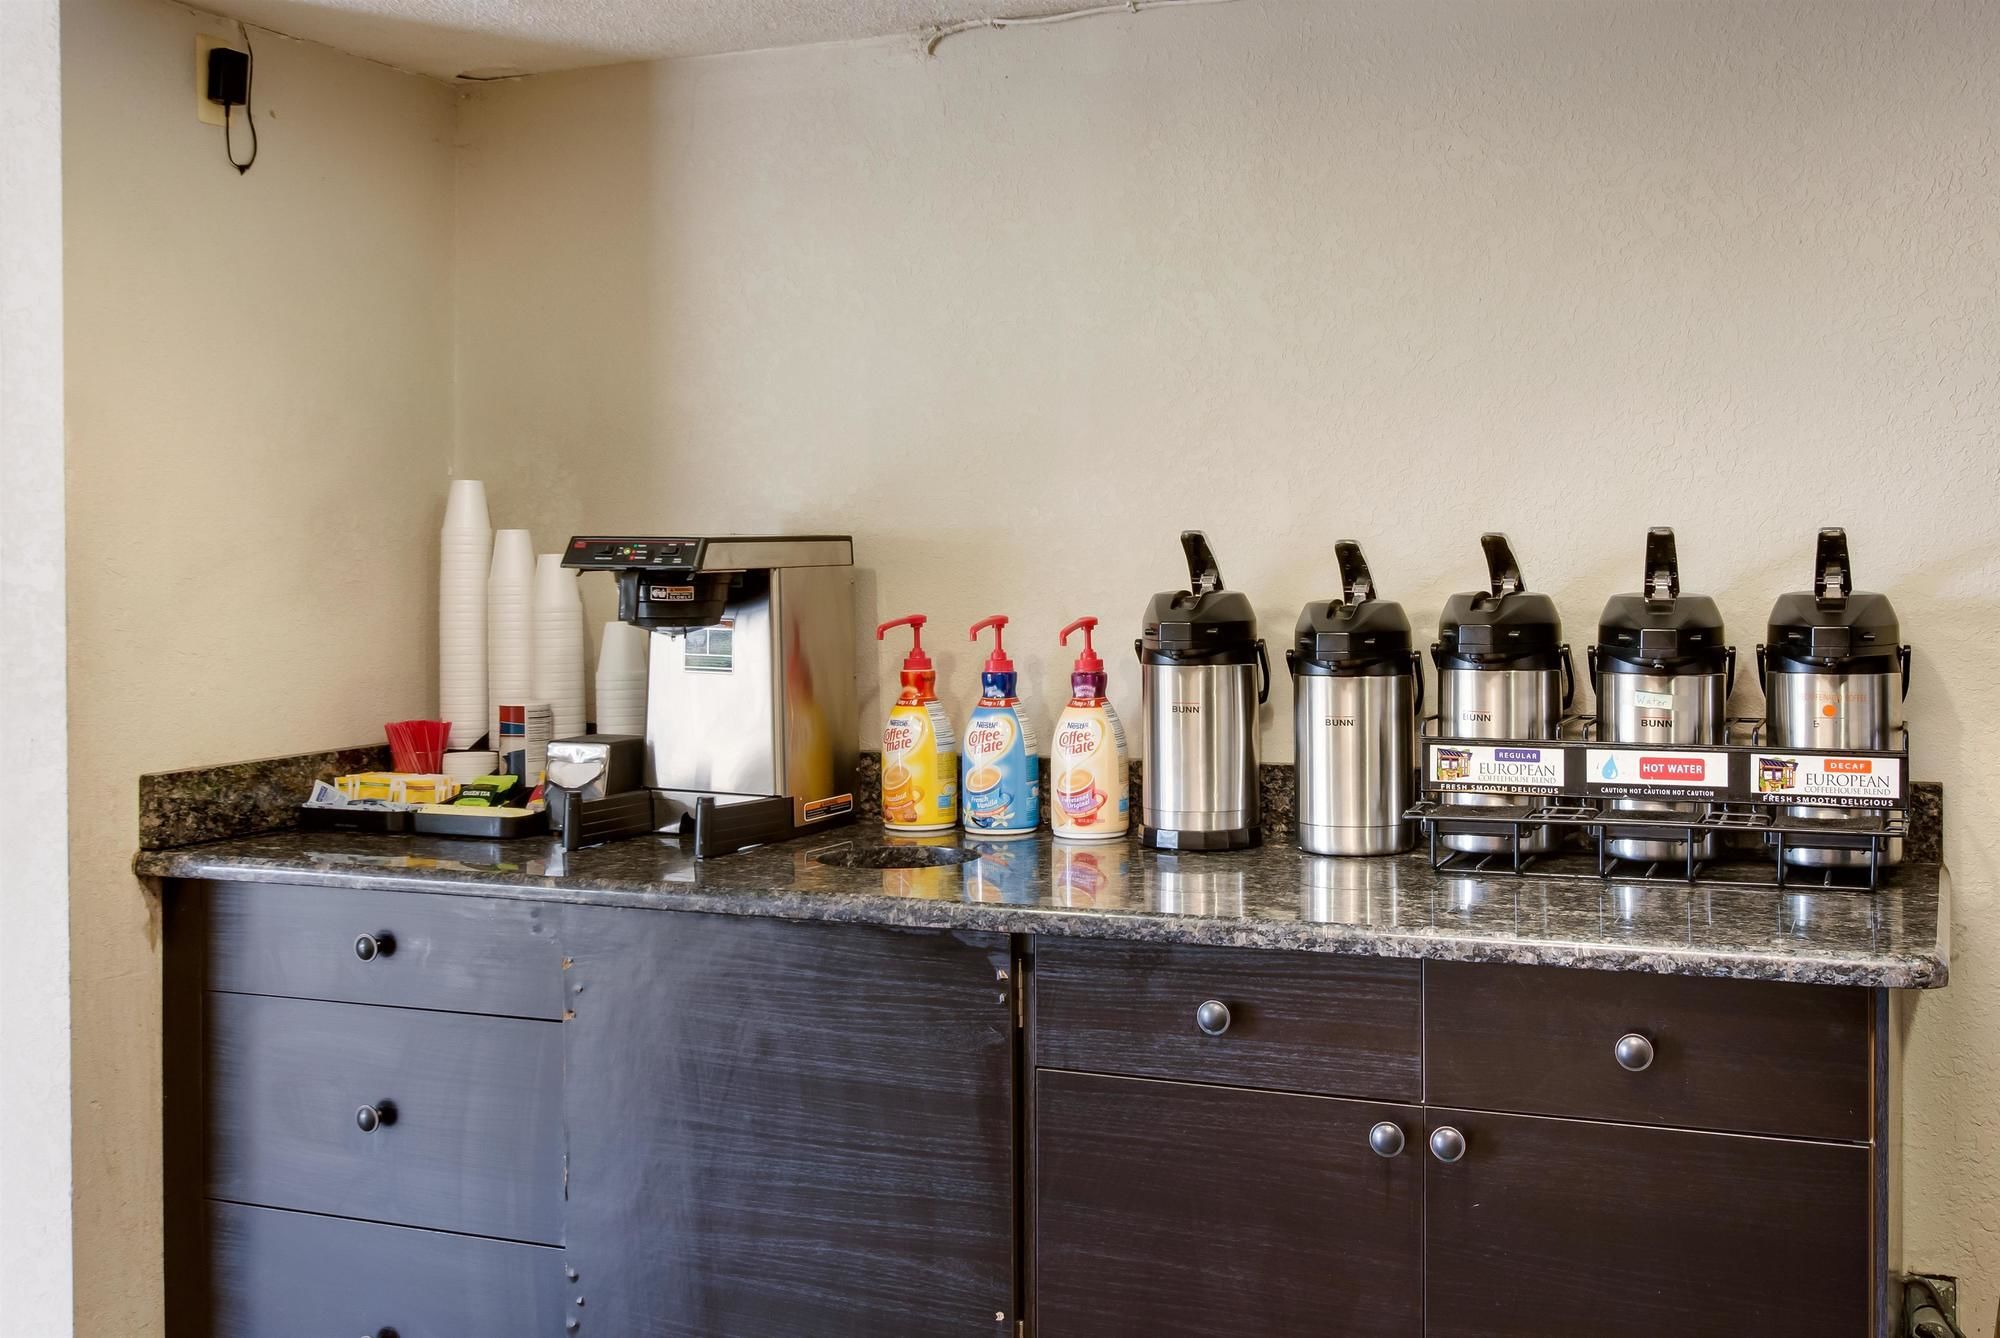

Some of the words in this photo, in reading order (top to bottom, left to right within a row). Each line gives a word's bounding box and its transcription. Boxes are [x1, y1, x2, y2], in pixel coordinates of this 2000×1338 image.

[1172, 705, 1200, 714] BUNN
[1324, 718, 1354, 727] BUNN
[1462, 713, 1492, 722] BUNN
[1640, 720, 1672, 728] BUNN
[886, 739, 912, 752] mate
[1498, 752, 1537, 760] REGULAR
[1479, 762, 1556, 777] EUROPEAN
[1642, 764, 1664, 773] HOT
[1667, 764, 1703, 774] WATER
[1830, 762, 1866, 770] DECAF
[1478, 775, 1530, 784] COFFEEHOUSE
[1532, 776, 1557, 784] BLEND
[1806, 773, 1890, 788] EUROPEAN
[1471, 784, 1508, 792] SMOOTH
[1511, 786, 1559, 794] DELICIOUS
[1600, 786, 1628, 794] CAUTION
[1644, 788, 1670, 796] CAUTION
[1804, 786, 1862, 795] COFFEEHOUSE
[1863, 787, 1892, 796] BLEND
[1762, 795, 1792, 803] FRESH
[1796, 796, 1837, 804] SMOOTH
[1841, 798, 1894, 807] DELICIOUS
